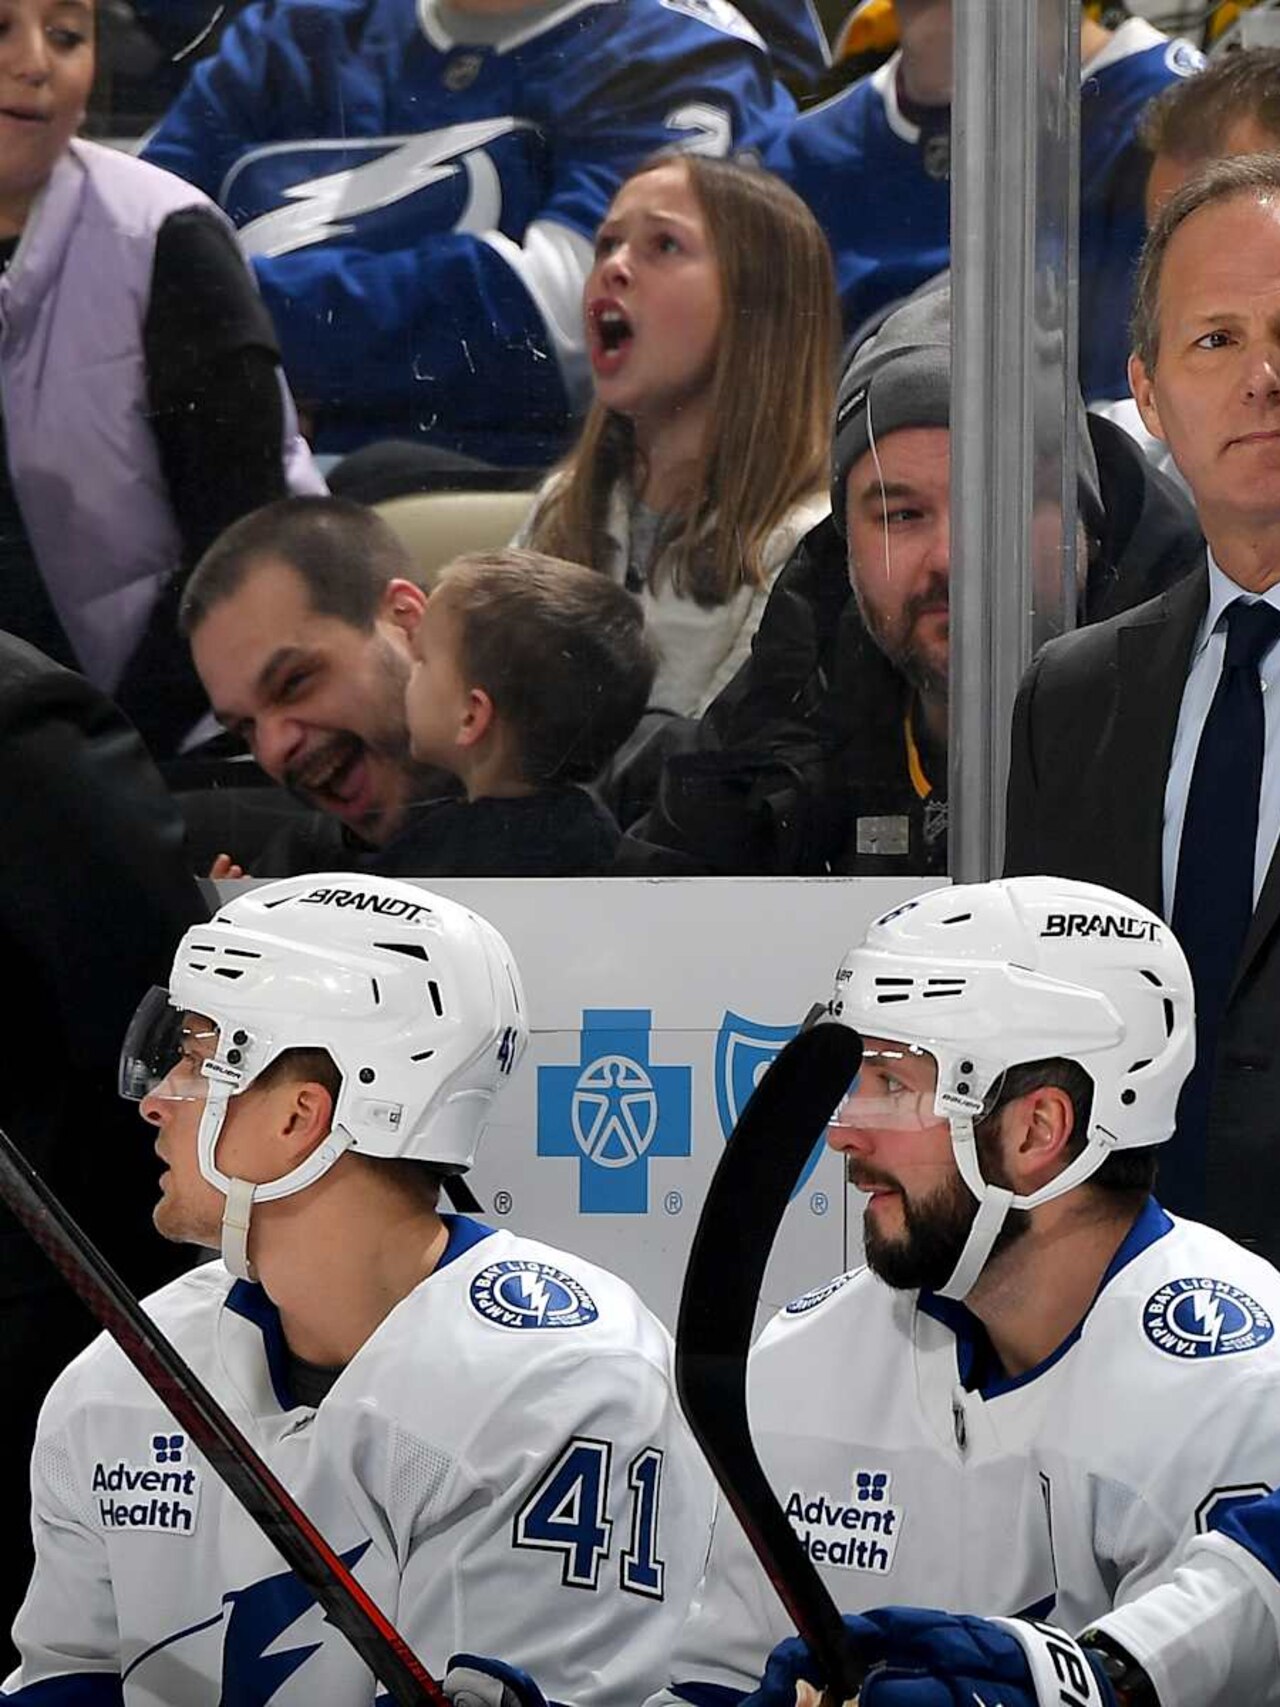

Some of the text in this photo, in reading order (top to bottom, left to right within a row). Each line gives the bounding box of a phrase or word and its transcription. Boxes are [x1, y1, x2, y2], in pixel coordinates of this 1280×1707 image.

[299, 889, 431, 920] BRANDT
[1040, 914, 1161, 941] BRANDT
[475, 1264, 503, 1286] BAY
[475, 1291, 523, 1326] TAMPA
[1148, 1285, 1176, 1314] BAY
[1179, 1278, 1271, 1329] LIGHTNING
[1148, 1317, 1197, 1355] TAMPA
[92, 1463, 196, 1495] Advent
[100, 1498, 192, 1530] Health
[512, 1434, 665, 1603] 41
[785, 1492, 896, 1535] Advent
